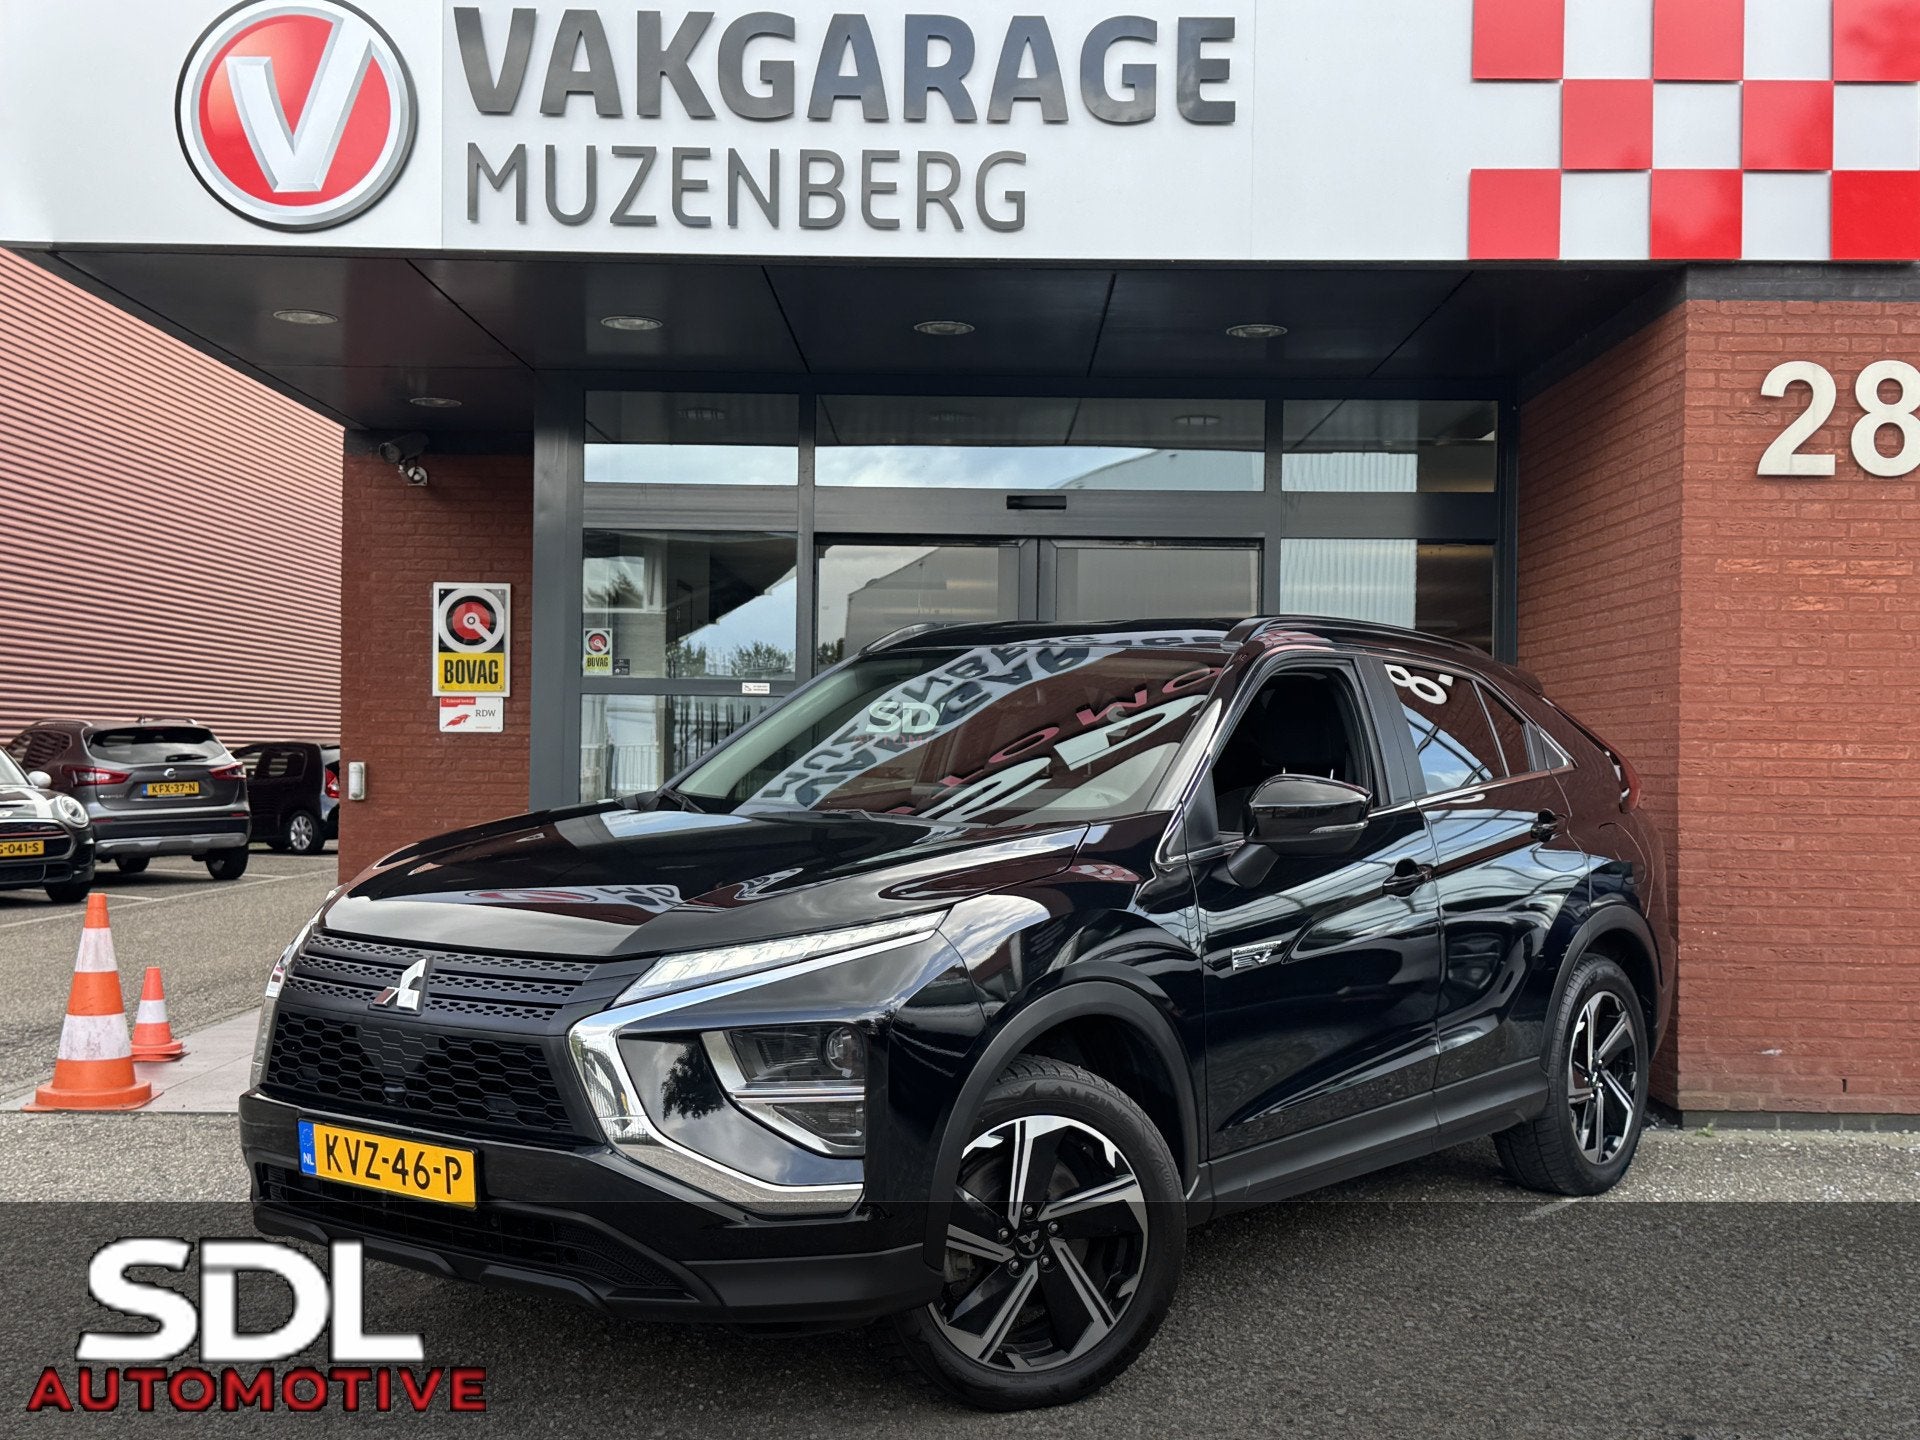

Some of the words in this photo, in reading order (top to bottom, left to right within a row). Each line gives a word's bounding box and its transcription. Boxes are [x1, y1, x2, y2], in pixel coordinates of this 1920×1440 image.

[453, 6, 1237, 126] VAKGARAGE
[466, 141, 1027, 233] MUZENBERG
[1757, 359, 1920, 477] 28
[443, 658, 499, 685] BOVAG
[587, 656, 609, 668] BOVAG
[475, 709, 497, 717] RDW
[865, 701, 946, 734] SD
[151, 783, 196, 794] KFX-37-N
[303, 1151, 315, 1166] NL
[325, 1132, 463, 1195] KVZ-46-P
